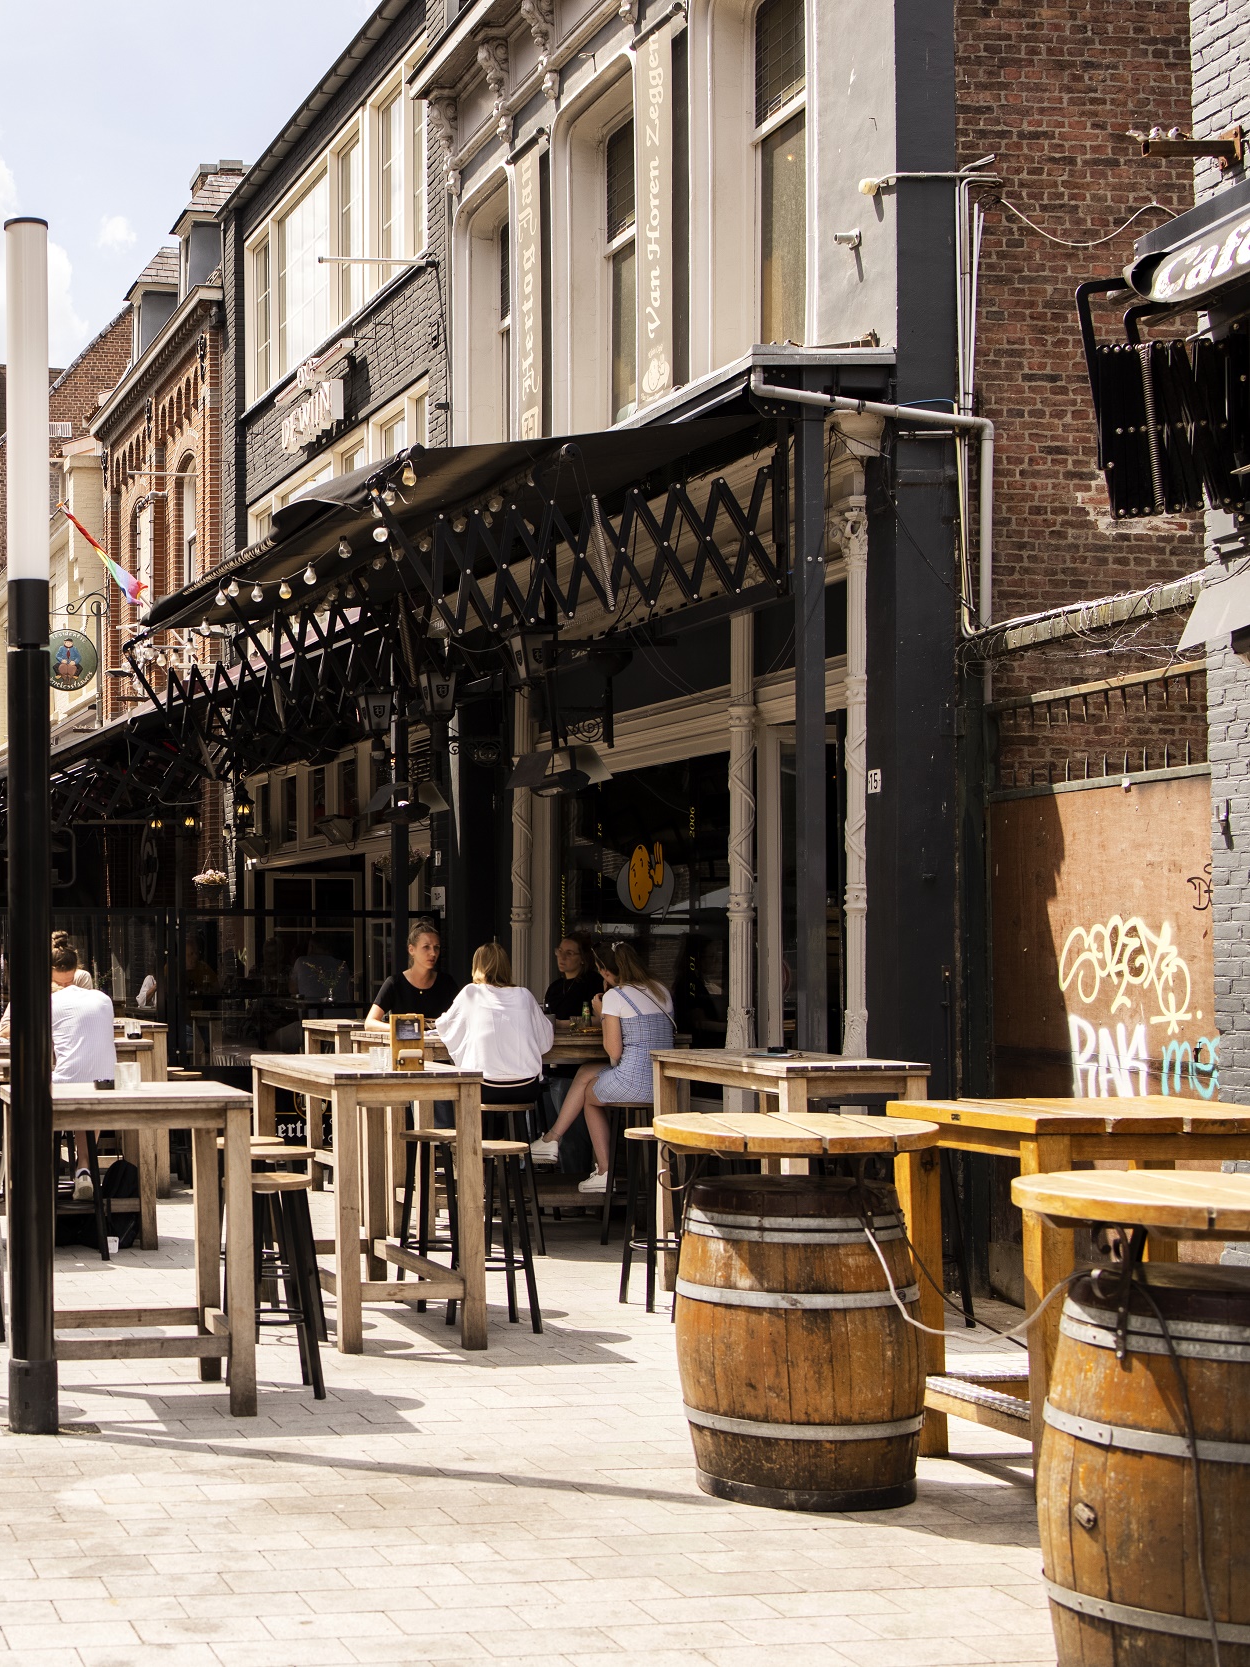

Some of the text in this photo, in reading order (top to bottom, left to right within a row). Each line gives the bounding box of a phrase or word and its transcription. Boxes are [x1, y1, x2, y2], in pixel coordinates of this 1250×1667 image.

[646, 30, 664, 147] Zeggen
[646, 156, 661, 258] Horen
[518, 154, 540, 400] Hertog Jan
[646, 266, 662, 338] Van
[688, 806, 696, 838] 2006
[869, 772, 878, 790] 15
